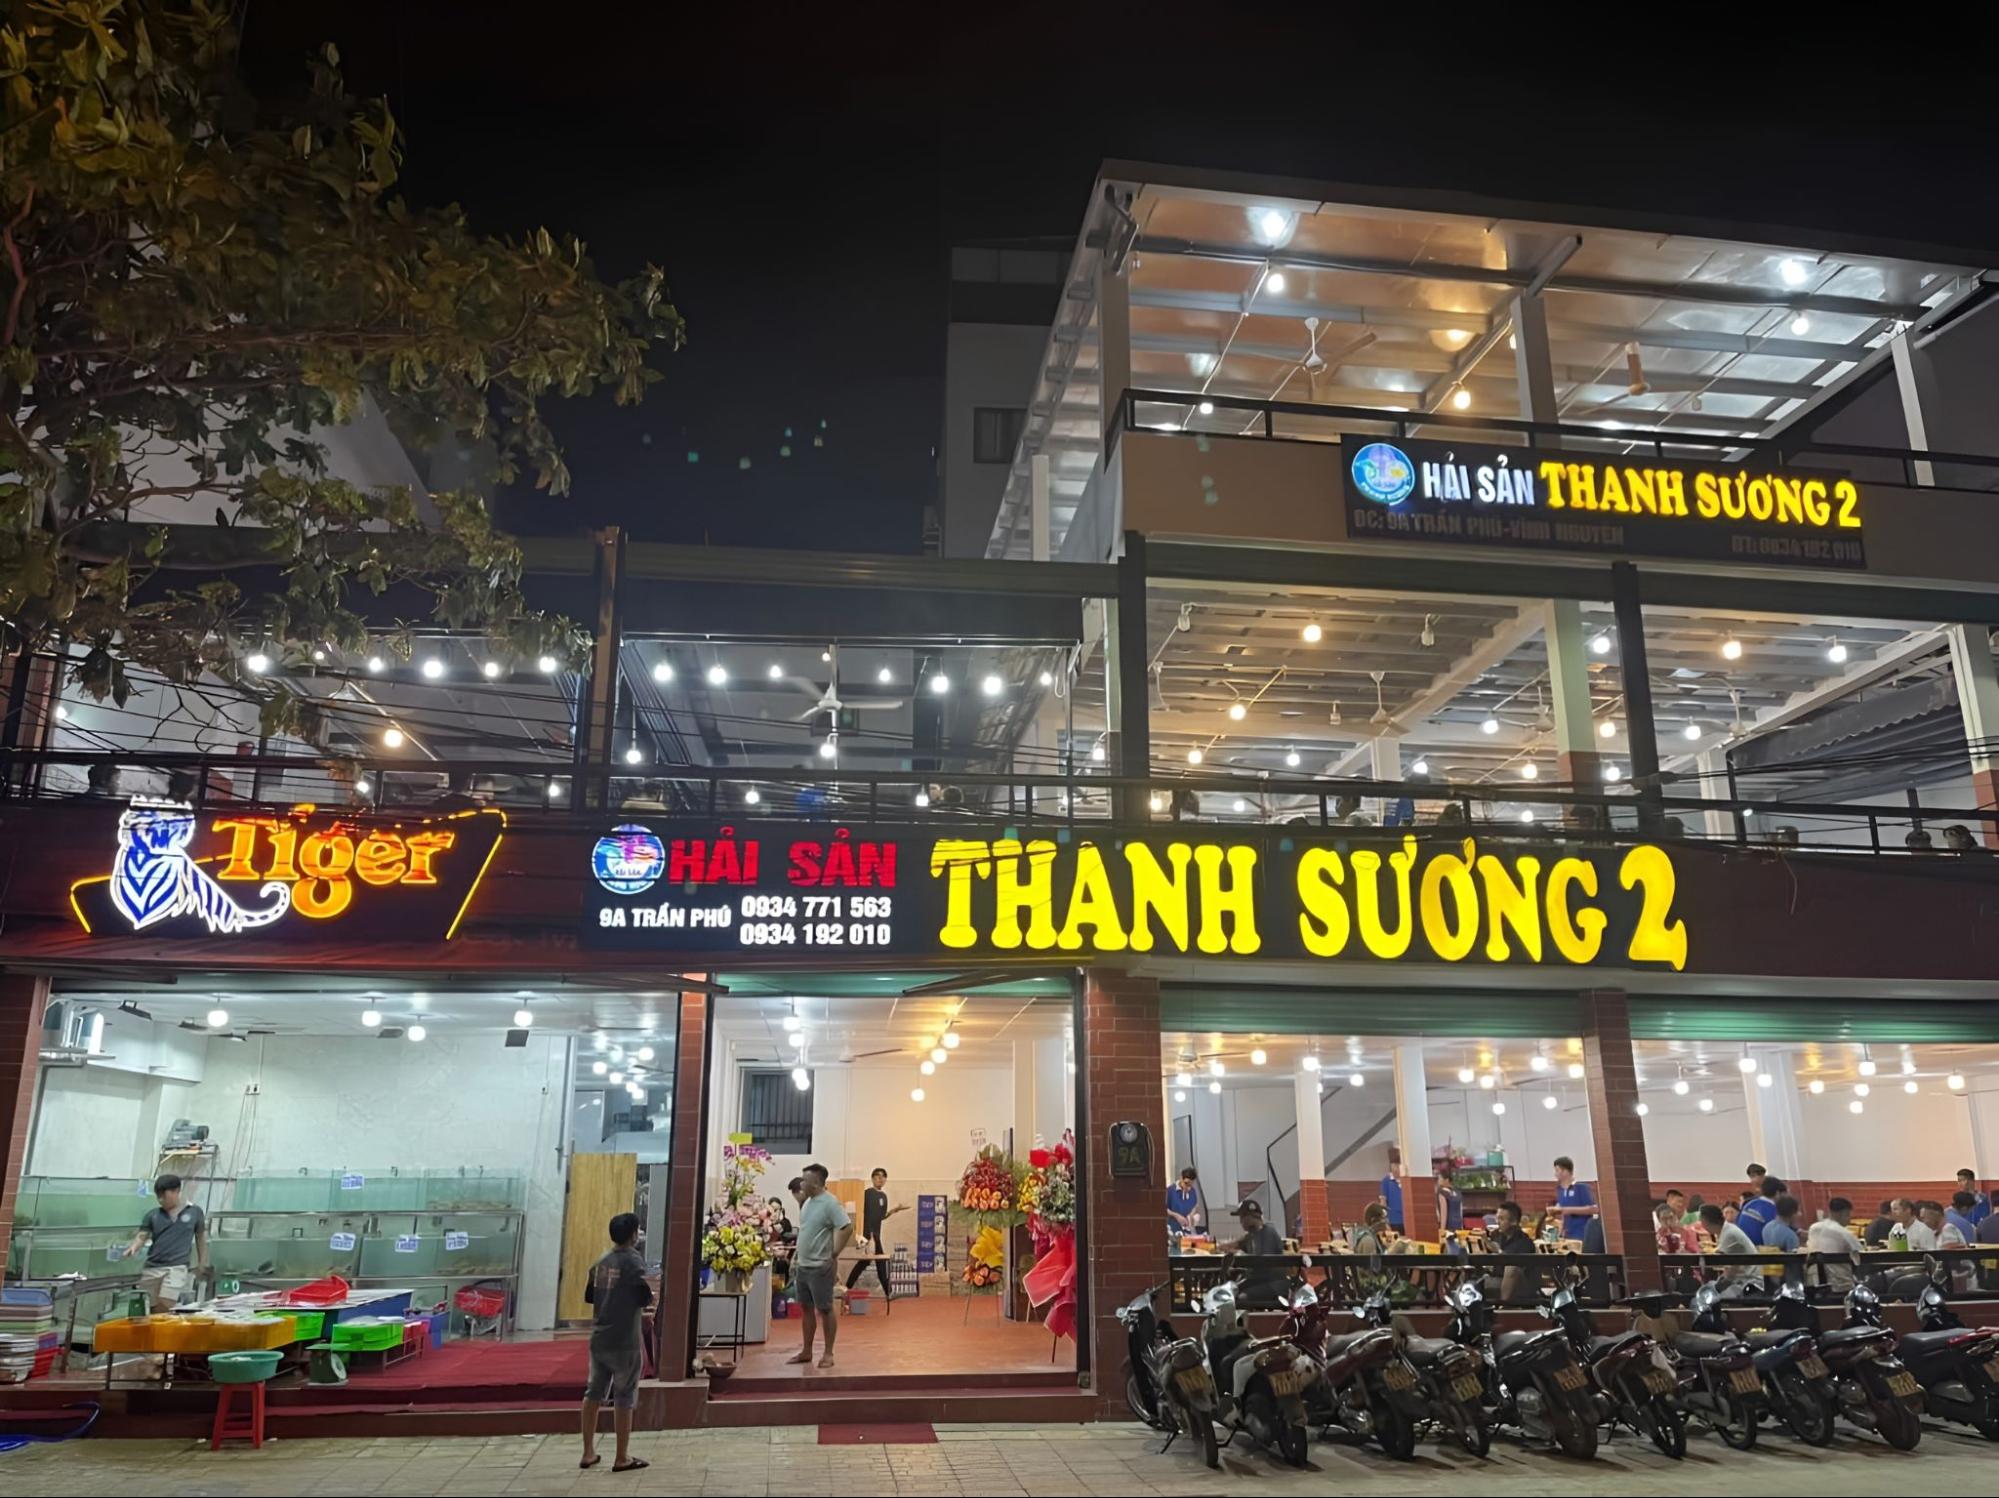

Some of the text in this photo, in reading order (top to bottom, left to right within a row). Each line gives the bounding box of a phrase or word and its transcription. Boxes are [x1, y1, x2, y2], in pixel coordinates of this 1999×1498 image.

[1422, 451, 1861, 528] HẢI SẢN THANH SƯƠNG 2
[211, 804, 455, 918] Tiger
[669, 826, 897, 888] HẢI SẢN
[599, 908, 626, 928] 9A
[740, 923, 891, 945] 0934 192 010
[741, 895, 892, 918] 0934 771 563
[931, 834, 1688, 972] THANH SƯƠNG 2
